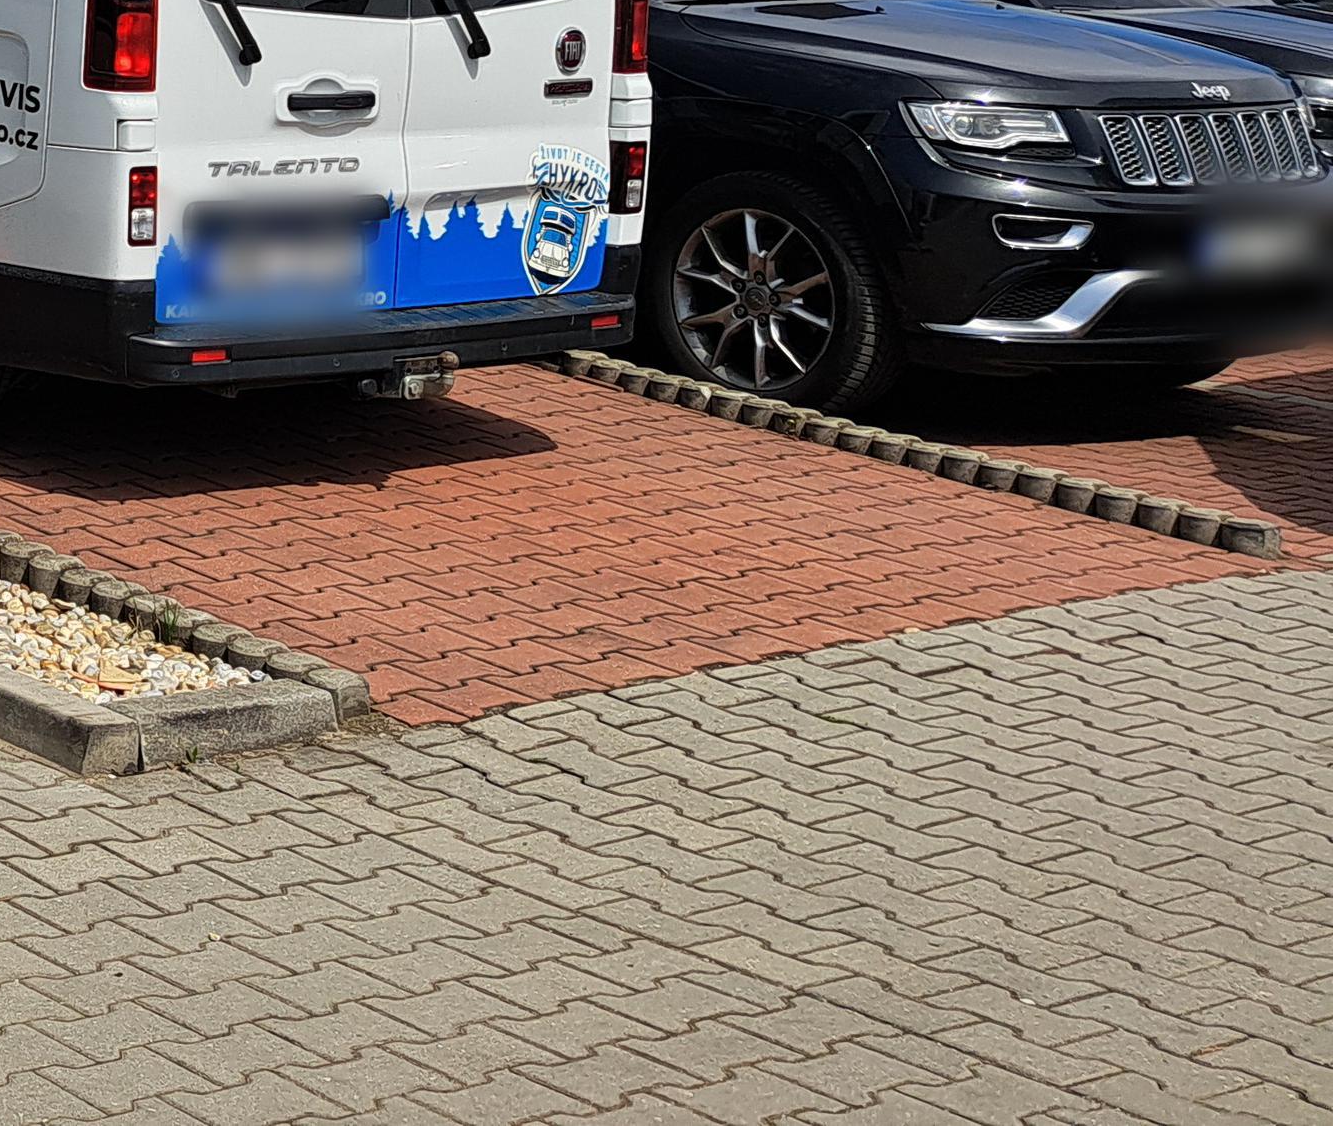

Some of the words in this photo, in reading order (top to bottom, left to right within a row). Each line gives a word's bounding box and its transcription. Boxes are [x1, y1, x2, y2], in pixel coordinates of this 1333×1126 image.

[564, 41, 582, 61] FIAT
[1190, 81, 1232, 101] Jeep
[207, 156, 361, 178] TALENTO
[548, 161, 599, 201] HYKRO
